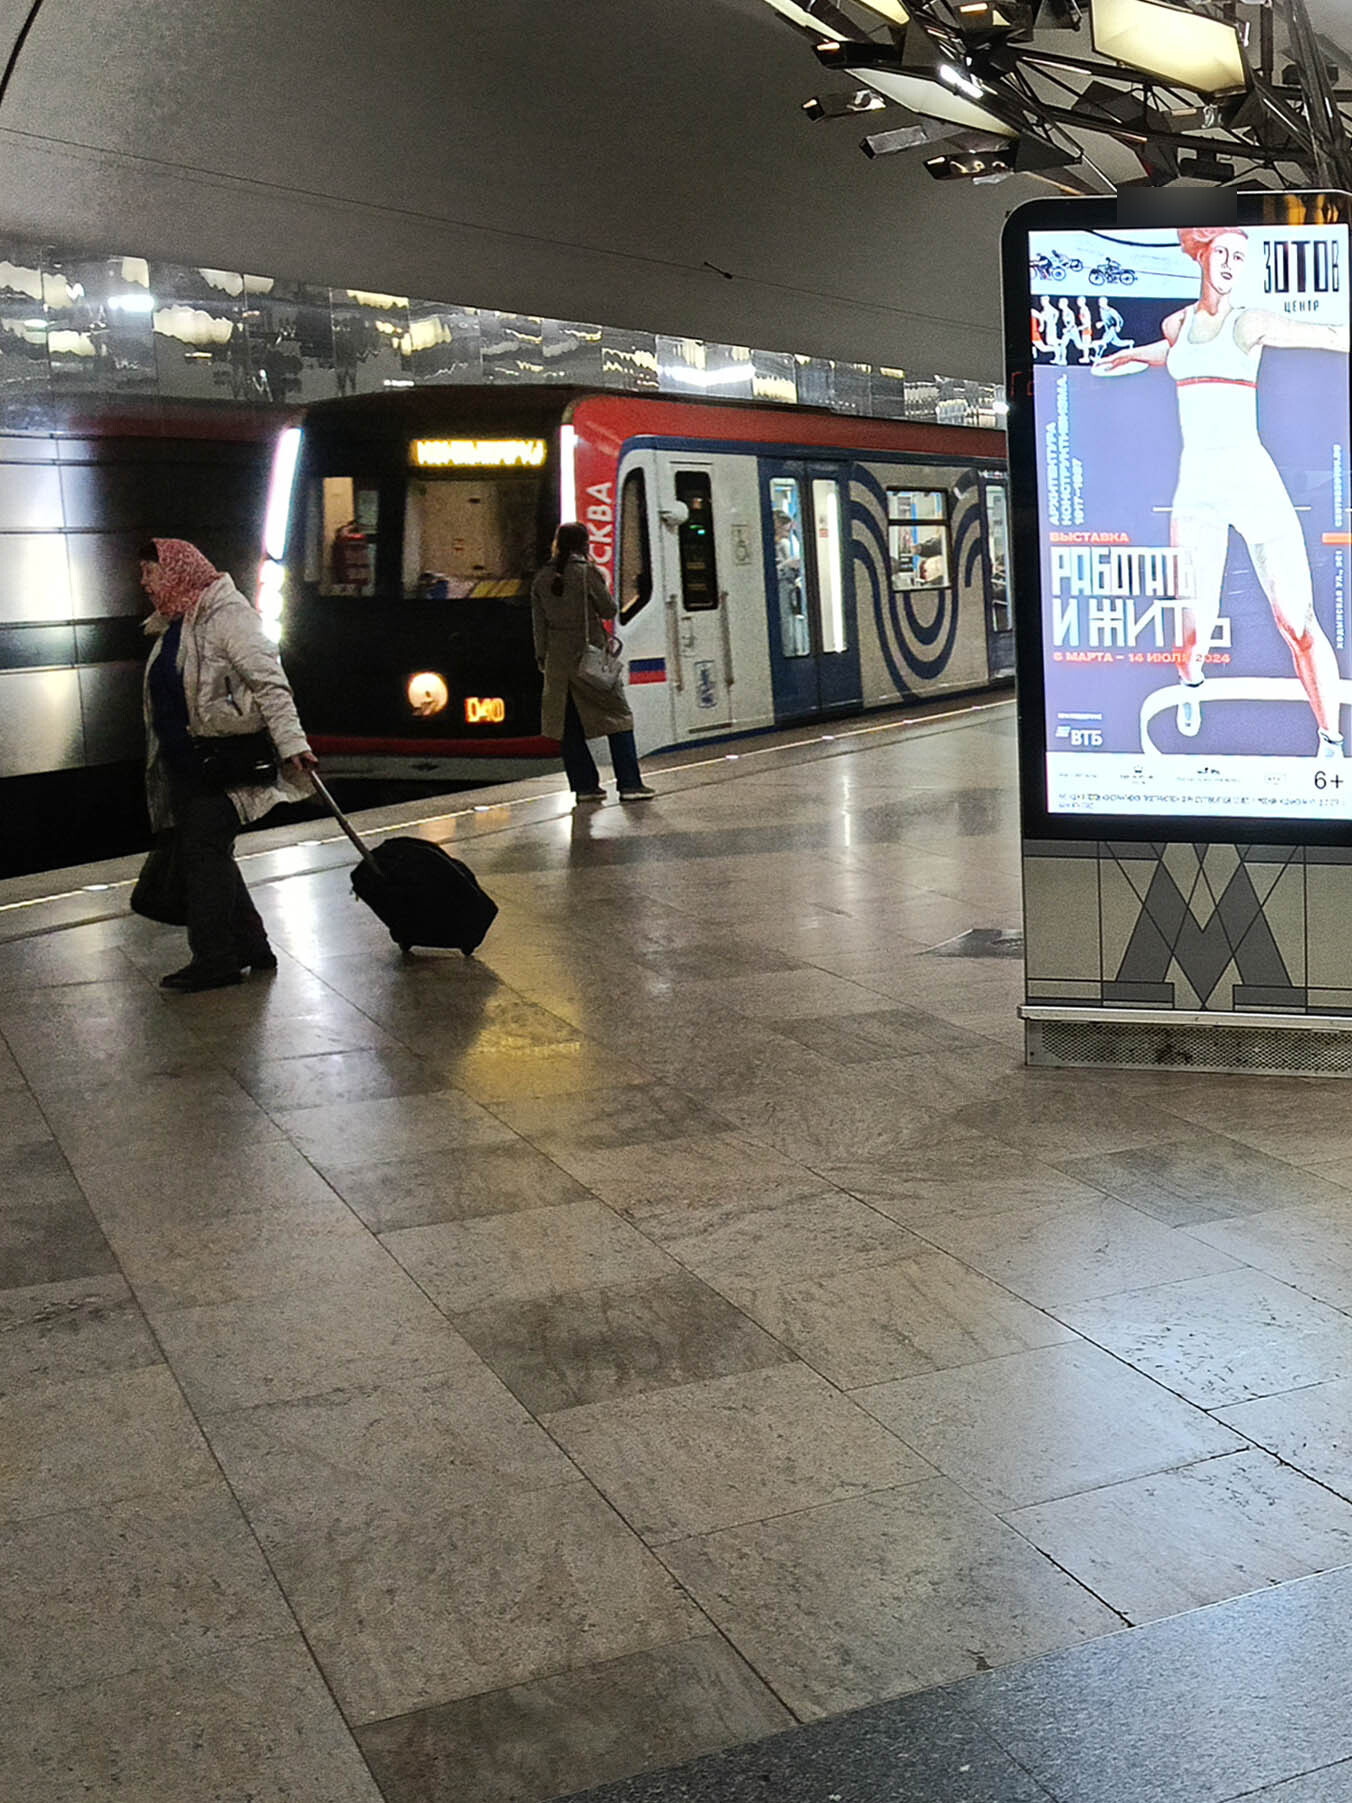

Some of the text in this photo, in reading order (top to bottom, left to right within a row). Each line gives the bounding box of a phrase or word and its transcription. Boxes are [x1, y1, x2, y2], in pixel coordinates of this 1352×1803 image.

[1263, 240, 1340, 294] ЗОТОВ
[1283, 300, 1320, 313] ЦЕНТР
[1045, 421, 1060, 526] АРХИТЕКТУРА
[586, 482, 613, 588] СКВА
[1049, 532, 1131, 544] ВЫСТАВКА
[1050, 546, 1197, 597] РАБОТАТЬ
[1052, 598, 1232, 648] И ЖИТЬ
[1065, 652, 1114, 663] МАРТА
[1147, 653, 1191, 664] ИЮЛ
[1071, 729, 1103, 746] ВТБ
[1314, 771, 1344, 790] 6+
